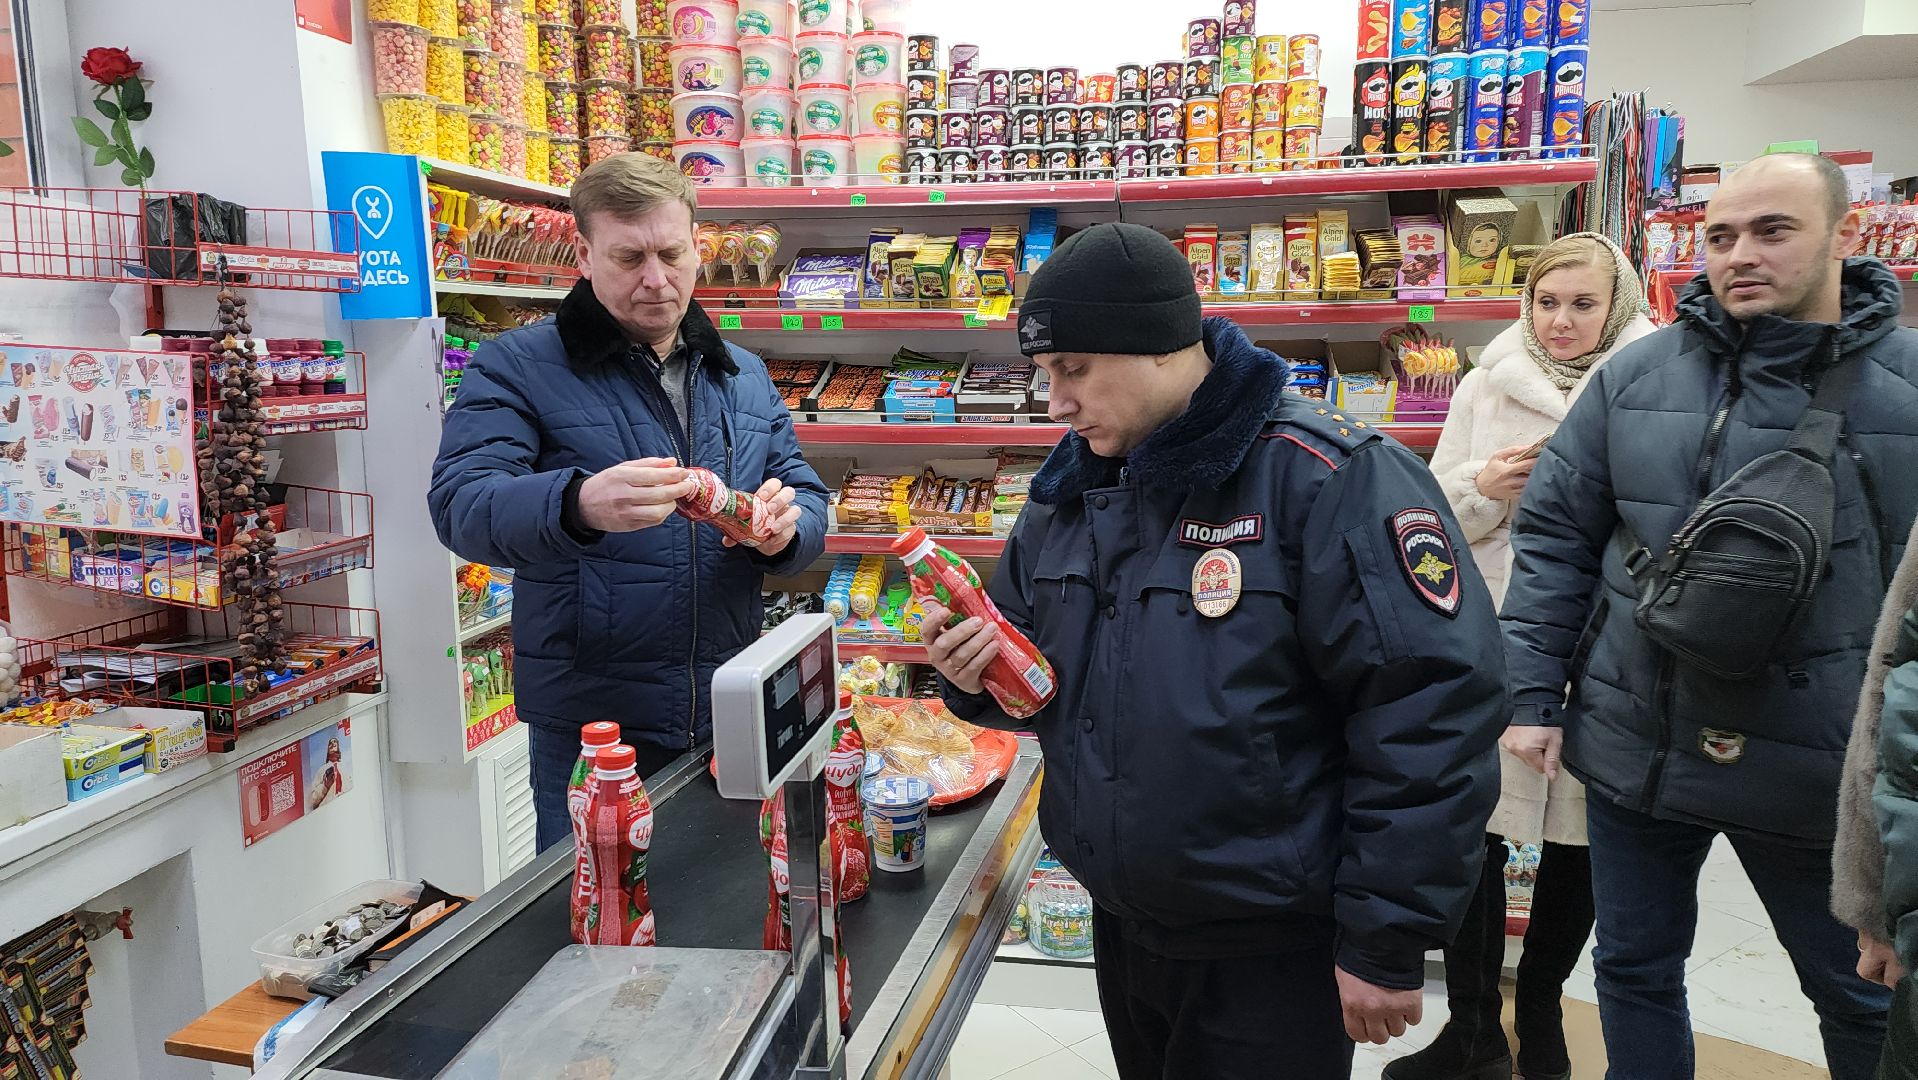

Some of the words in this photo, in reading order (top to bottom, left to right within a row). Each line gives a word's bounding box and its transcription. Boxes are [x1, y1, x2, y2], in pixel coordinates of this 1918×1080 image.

[1555, 83, 1583, 98] PRINGLES
[1396, 105, 1418, 118] HOT
[1323, 228, 1344, 236] Alpen
[1190, 246, 1211, 254] Alpen
[801, 257, 845, 271] Milka
[352, 269, 410, 287] ДЕСЬ
[793, 276, 836, 294] Milka
[1397, 512, 1437, 528] ПОЛИЦИЯ
[1185, 519, 1255, 543] ПОЛИЦИЯ
[1405, 533, 1445, 553] РОССИЯ
[85, 564, 132, 577] mentos
[1197, 589, 1232, 600] ПОЛИЦИЯ
[158, 726, 204, 750] Turbo
[241, 743, 298, 776] ПОДКЛЮЧИТЕ
[260, 759, 287, 777] ЗДЕСЬ
[826, 765, 862, 782] Чудо
